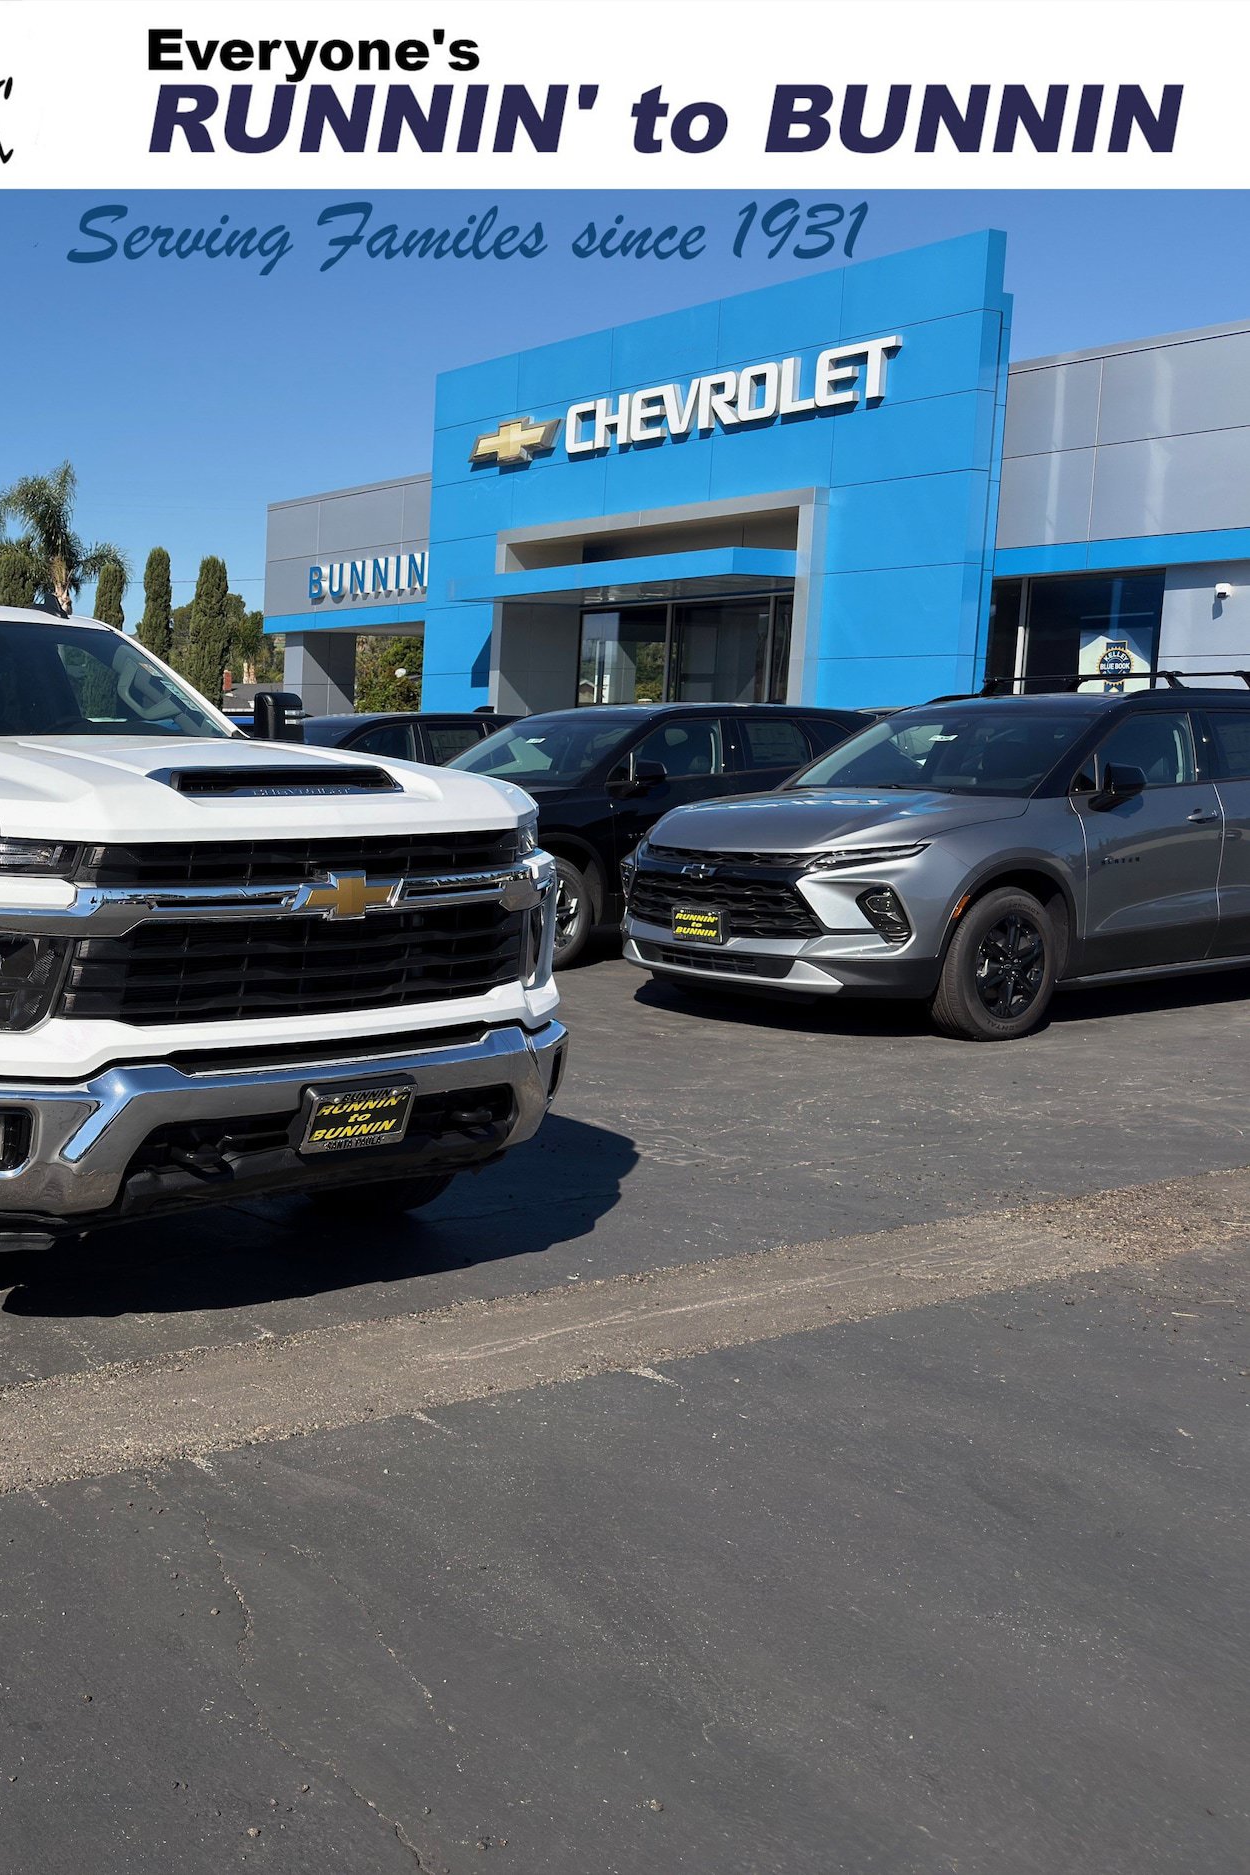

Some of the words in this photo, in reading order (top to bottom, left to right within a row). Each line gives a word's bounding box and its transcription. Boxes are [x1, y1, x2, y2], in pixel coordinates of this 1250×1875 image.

[565, 334, 902, 455] CHEVROLET
[309, 552, 429, 598] BUNNIN
[1103, 650, 1130, 662] KELLEY
[1114, 662, 1130, 670] BOOK
[675, 912, 718, 923] RUNNIN'
[675, 926, 717, 937] BUNNIN
[316, 1094, 409, 1117] RUNNIN'
[348, 1112, 371, 1123] to
[310, 1119, 397, 1142] BUNNIN
